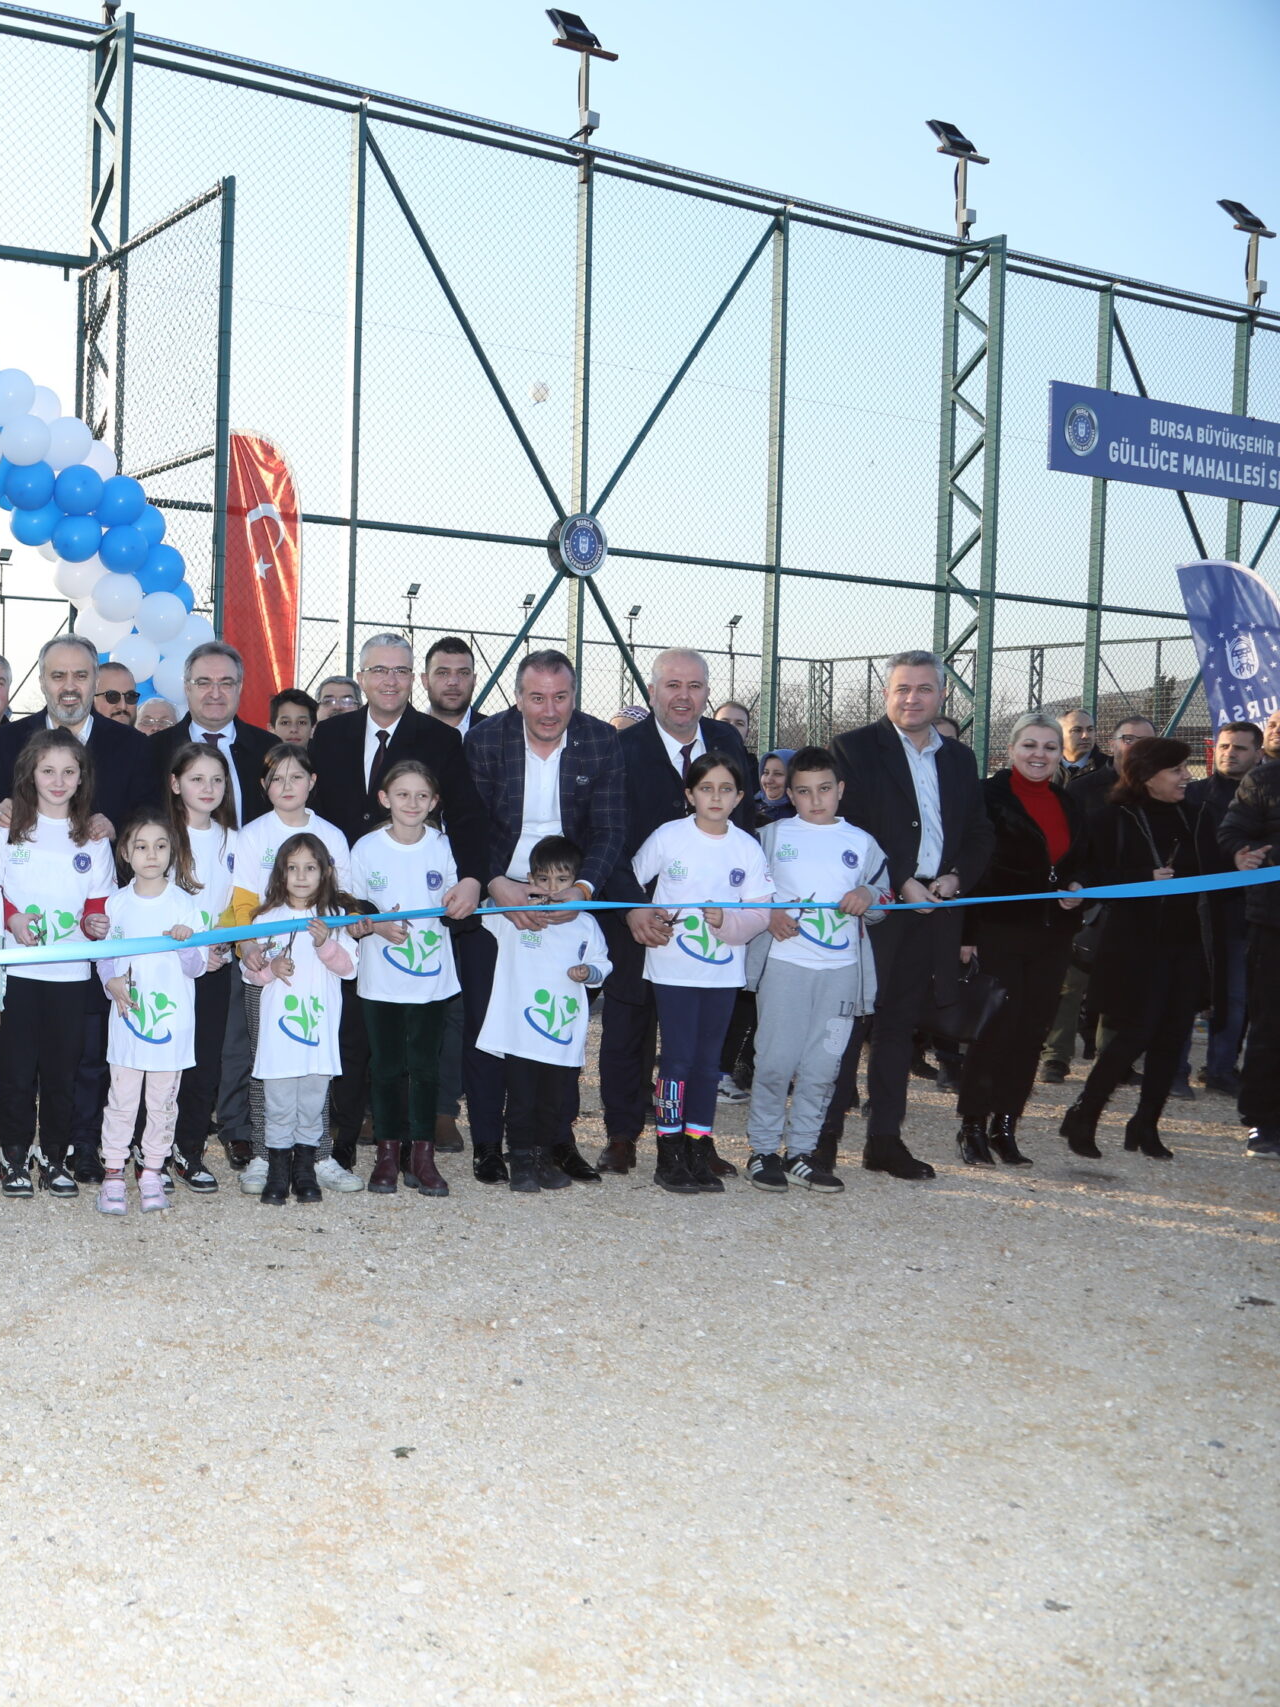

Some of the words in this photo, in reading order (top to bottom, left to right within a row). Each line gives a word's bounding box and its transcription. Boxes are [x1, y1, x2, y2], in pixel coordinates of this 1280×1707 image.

[1150, 417, 1194, 442] BURSA
[1197, 424, 1274, 456] BÜYÜKŞEHİR
[1109, 437, 1179, 473] GÜLLÜCE
[1183, 453, 1266, 488] MAHALLESİ
[1269, 469, 1280, 490] S
